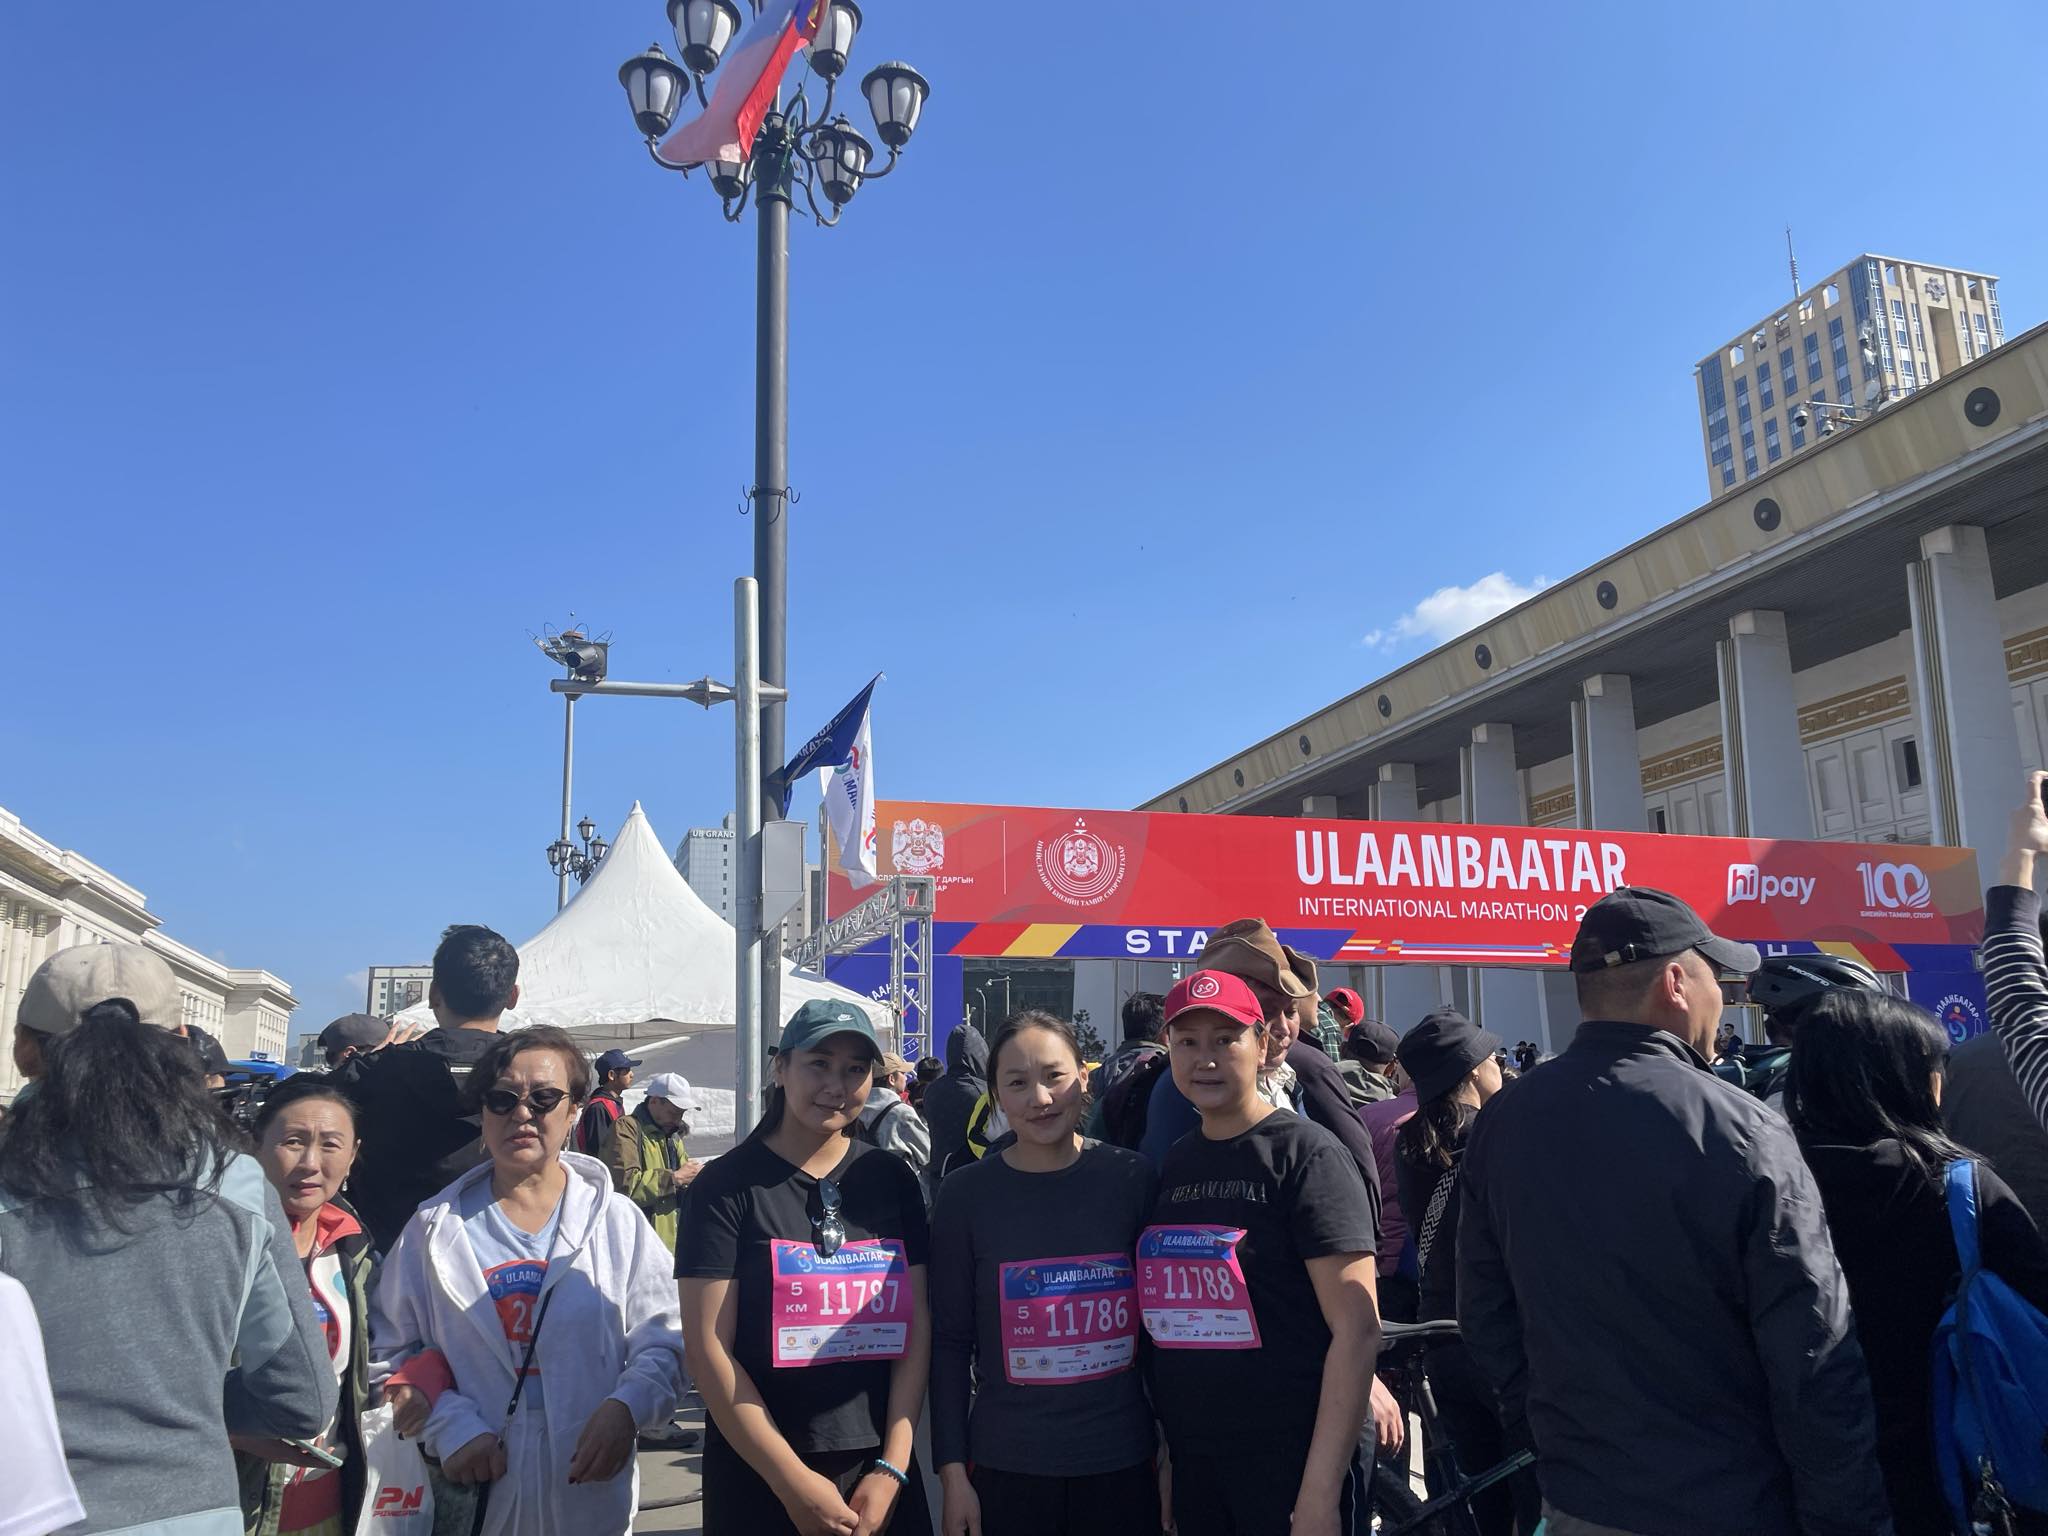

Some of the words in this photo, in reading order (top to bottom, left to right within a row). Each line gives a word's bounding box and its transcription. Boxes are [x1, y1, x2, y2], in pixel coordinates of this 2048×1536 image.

[705, 830, 736, 838] GRAND
[1296, 831, 1630, 893] ULAANBAATAR
[942, 876, 974, 884] ДАРГЫН
[1856, 863, 1931, 909] 100
[1299, 897, 1457, 919] INTERNATIONAL
[1461, 900, 1568, 921] MARATHON
[1126, 929, 1209, 955] STA
[1934, 994, 1980, 1018] УЛААНБААТАР
[1162, 1235, 1214, 1247] ULAANBAATAR
[1043, 1268, 1115, 1284] ULAANBAATAR
[1145, 1266, 1153, 1279] 5
[791, 1282, 803, 1296] 5
[1163, 1265, 1235, 1301] 11788
[819, 1280, 899, 1316] 11787
[1144, 1287, 1156, 1296] KM
[785, 1303, 808, 1313] KM
[1017, 1305, 1030, 1320] 5
[1045, 1296, 1129, 1338] 11786
[1014, 1326, 1035, 1336] KM
